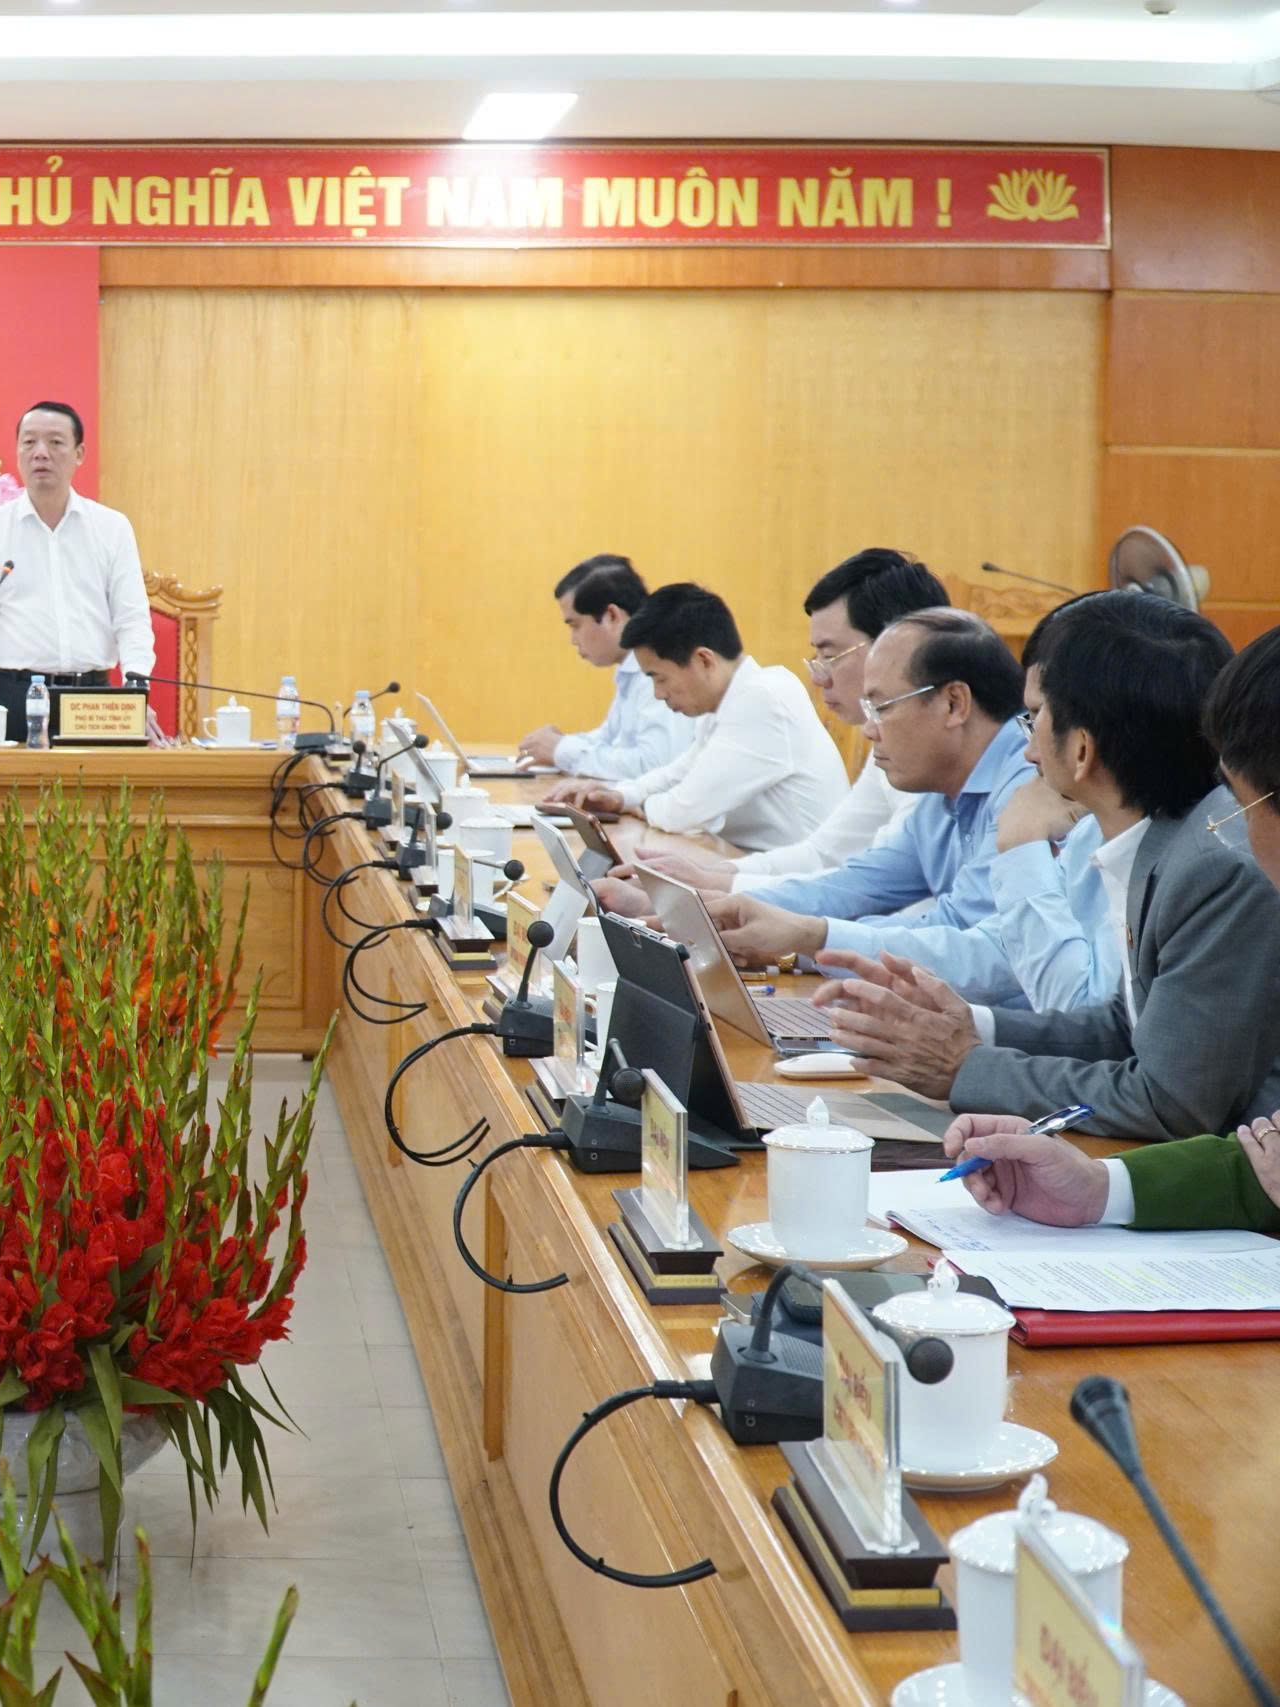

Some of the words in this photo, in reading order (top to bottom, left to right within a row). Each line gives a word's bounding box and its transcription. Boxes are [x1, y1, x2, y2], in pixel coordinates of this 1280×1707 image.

[92, 166, 270, 228] NGHĨA
[288, 166, 410, 237] VIỆT
[426, 177, 563, 228] NAM
[582, 166, 758, 228] MUÔN
[778, 166, 913, 228] NĂM
[936, 178, 952, 228] !
